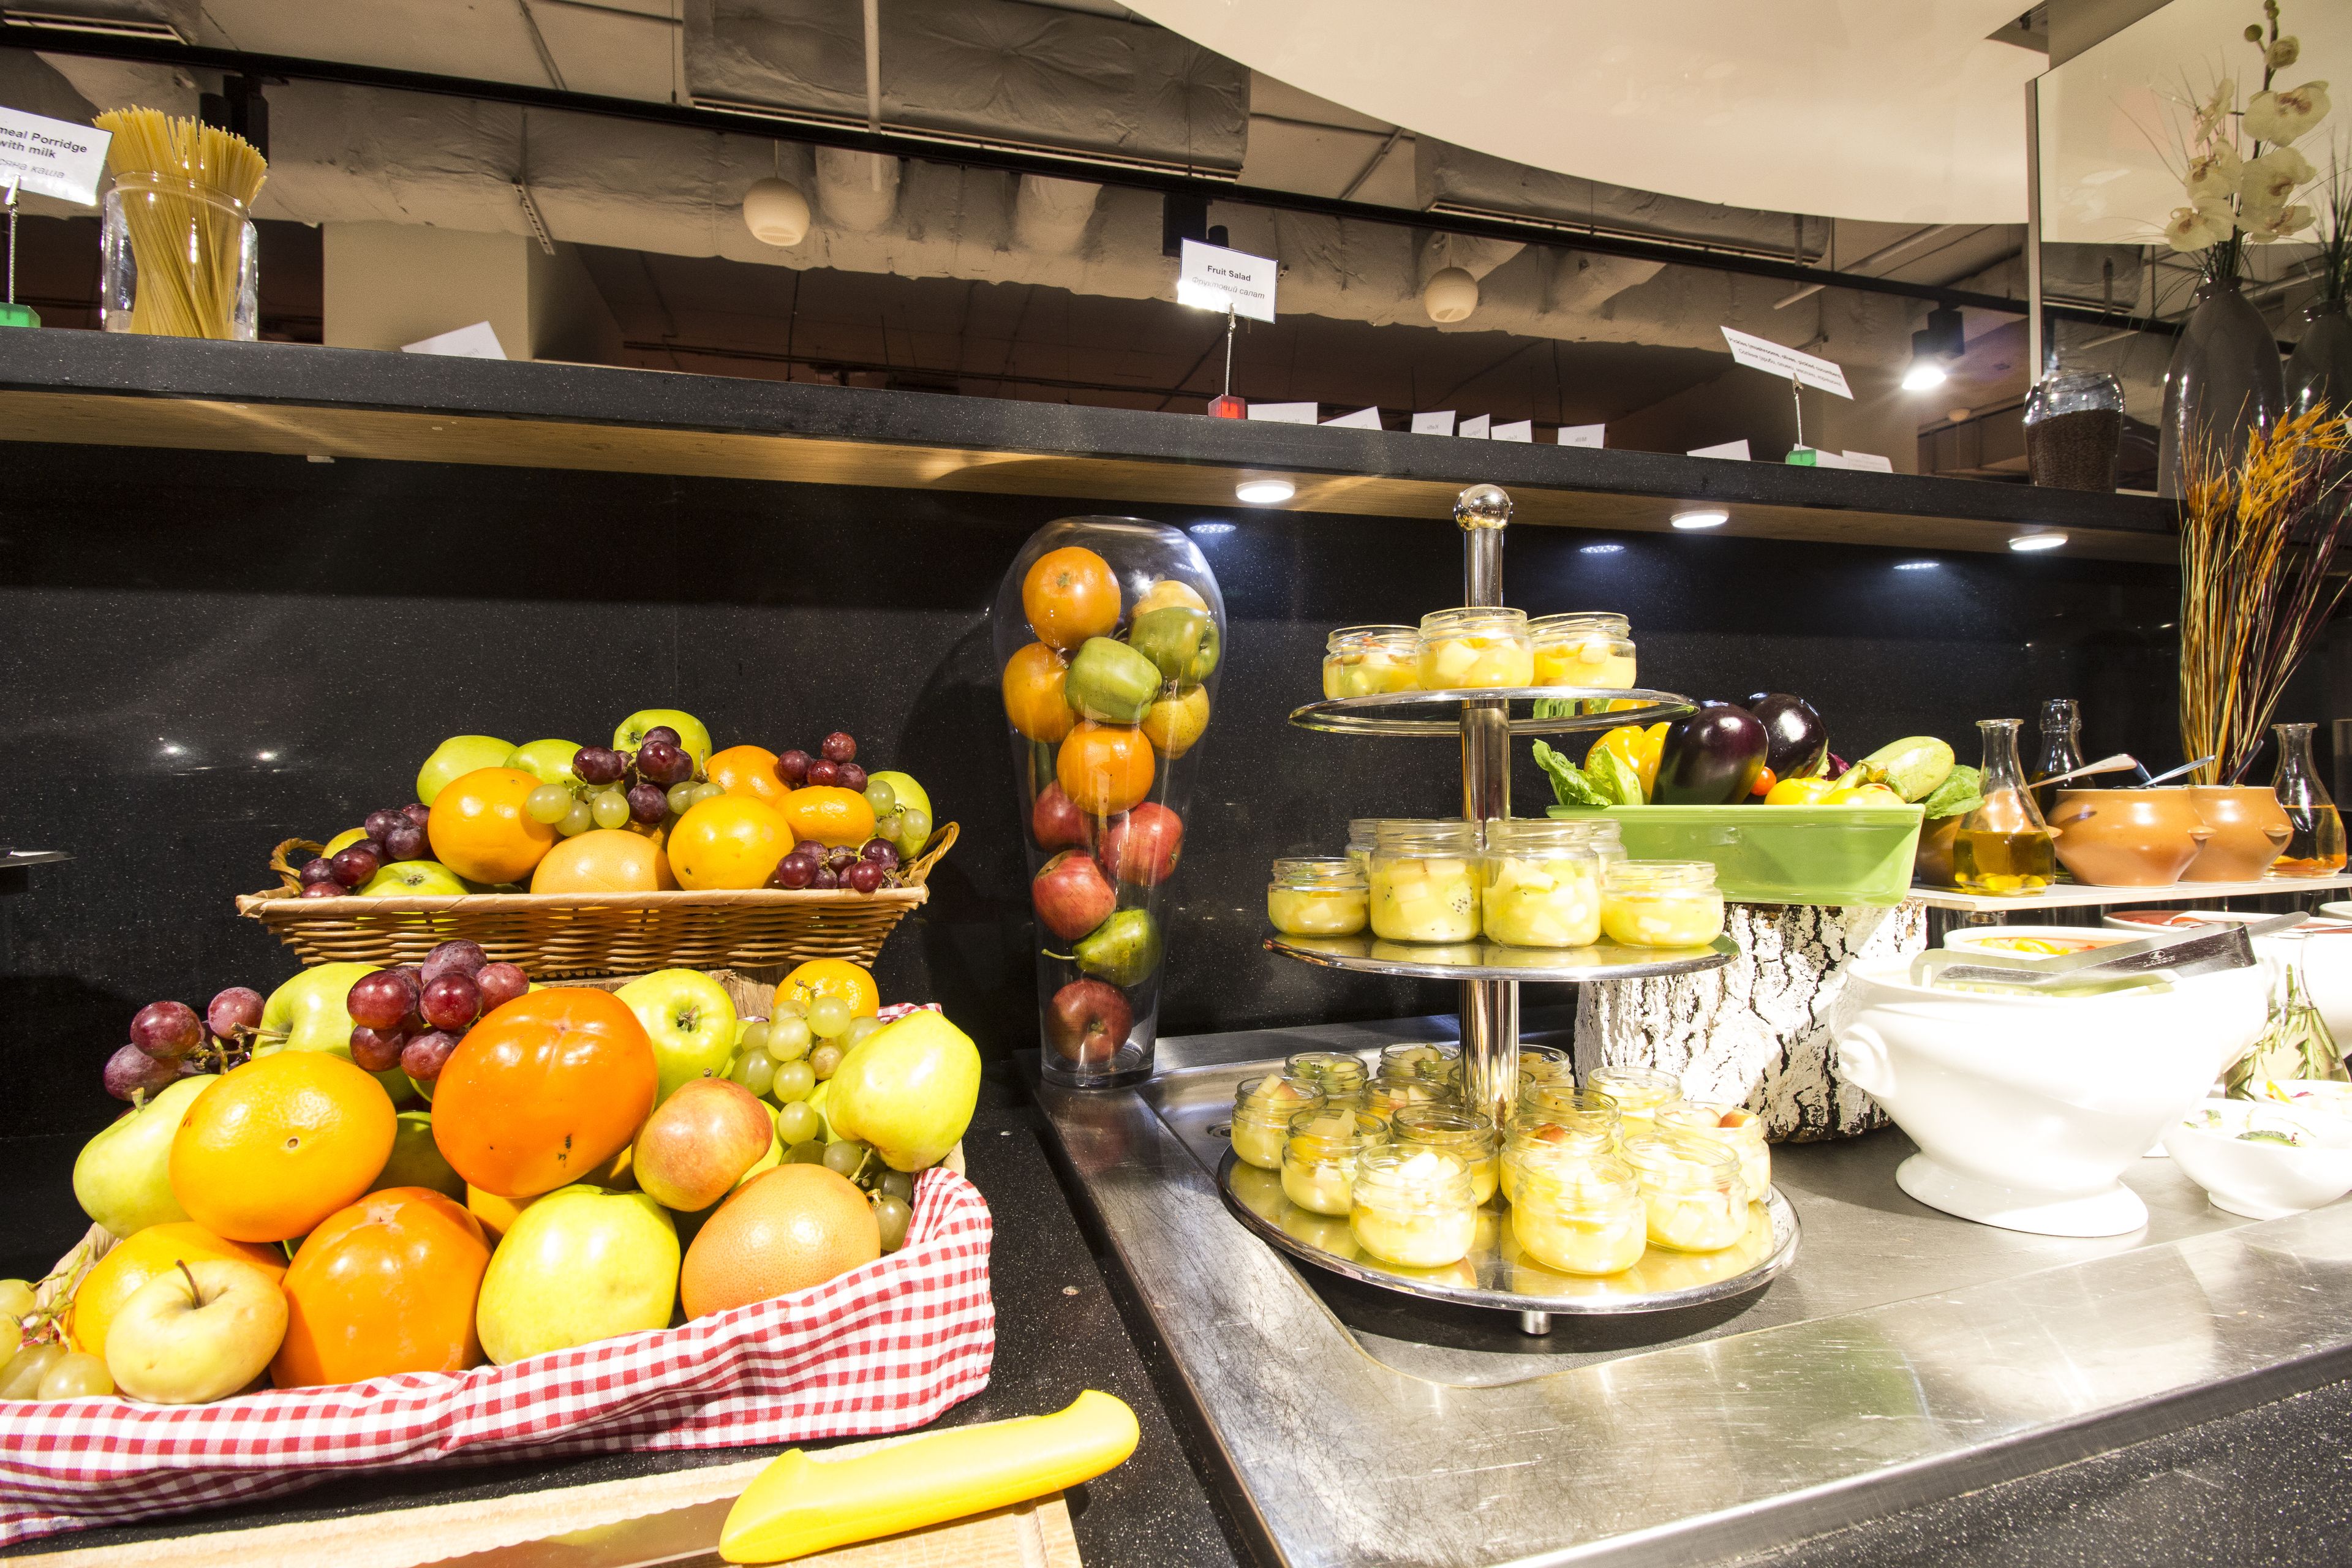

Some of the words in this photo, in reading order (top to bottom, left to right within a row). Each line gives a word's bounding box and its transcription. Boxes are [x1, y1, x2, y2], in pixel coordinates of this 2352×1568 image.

[0, 140, 24, 151] with
[29, 146, 56, 159] milk
[31, 132, 88, 153] Porridge
[31, 166, 65, 178] каша
[1207, 265, 1227, 276] Fruit
[1229, 270, 1251, 282] Salad
[1192, 276, 1238, 293] Фруктовий
[1240, 288, 1265, 300] салат
